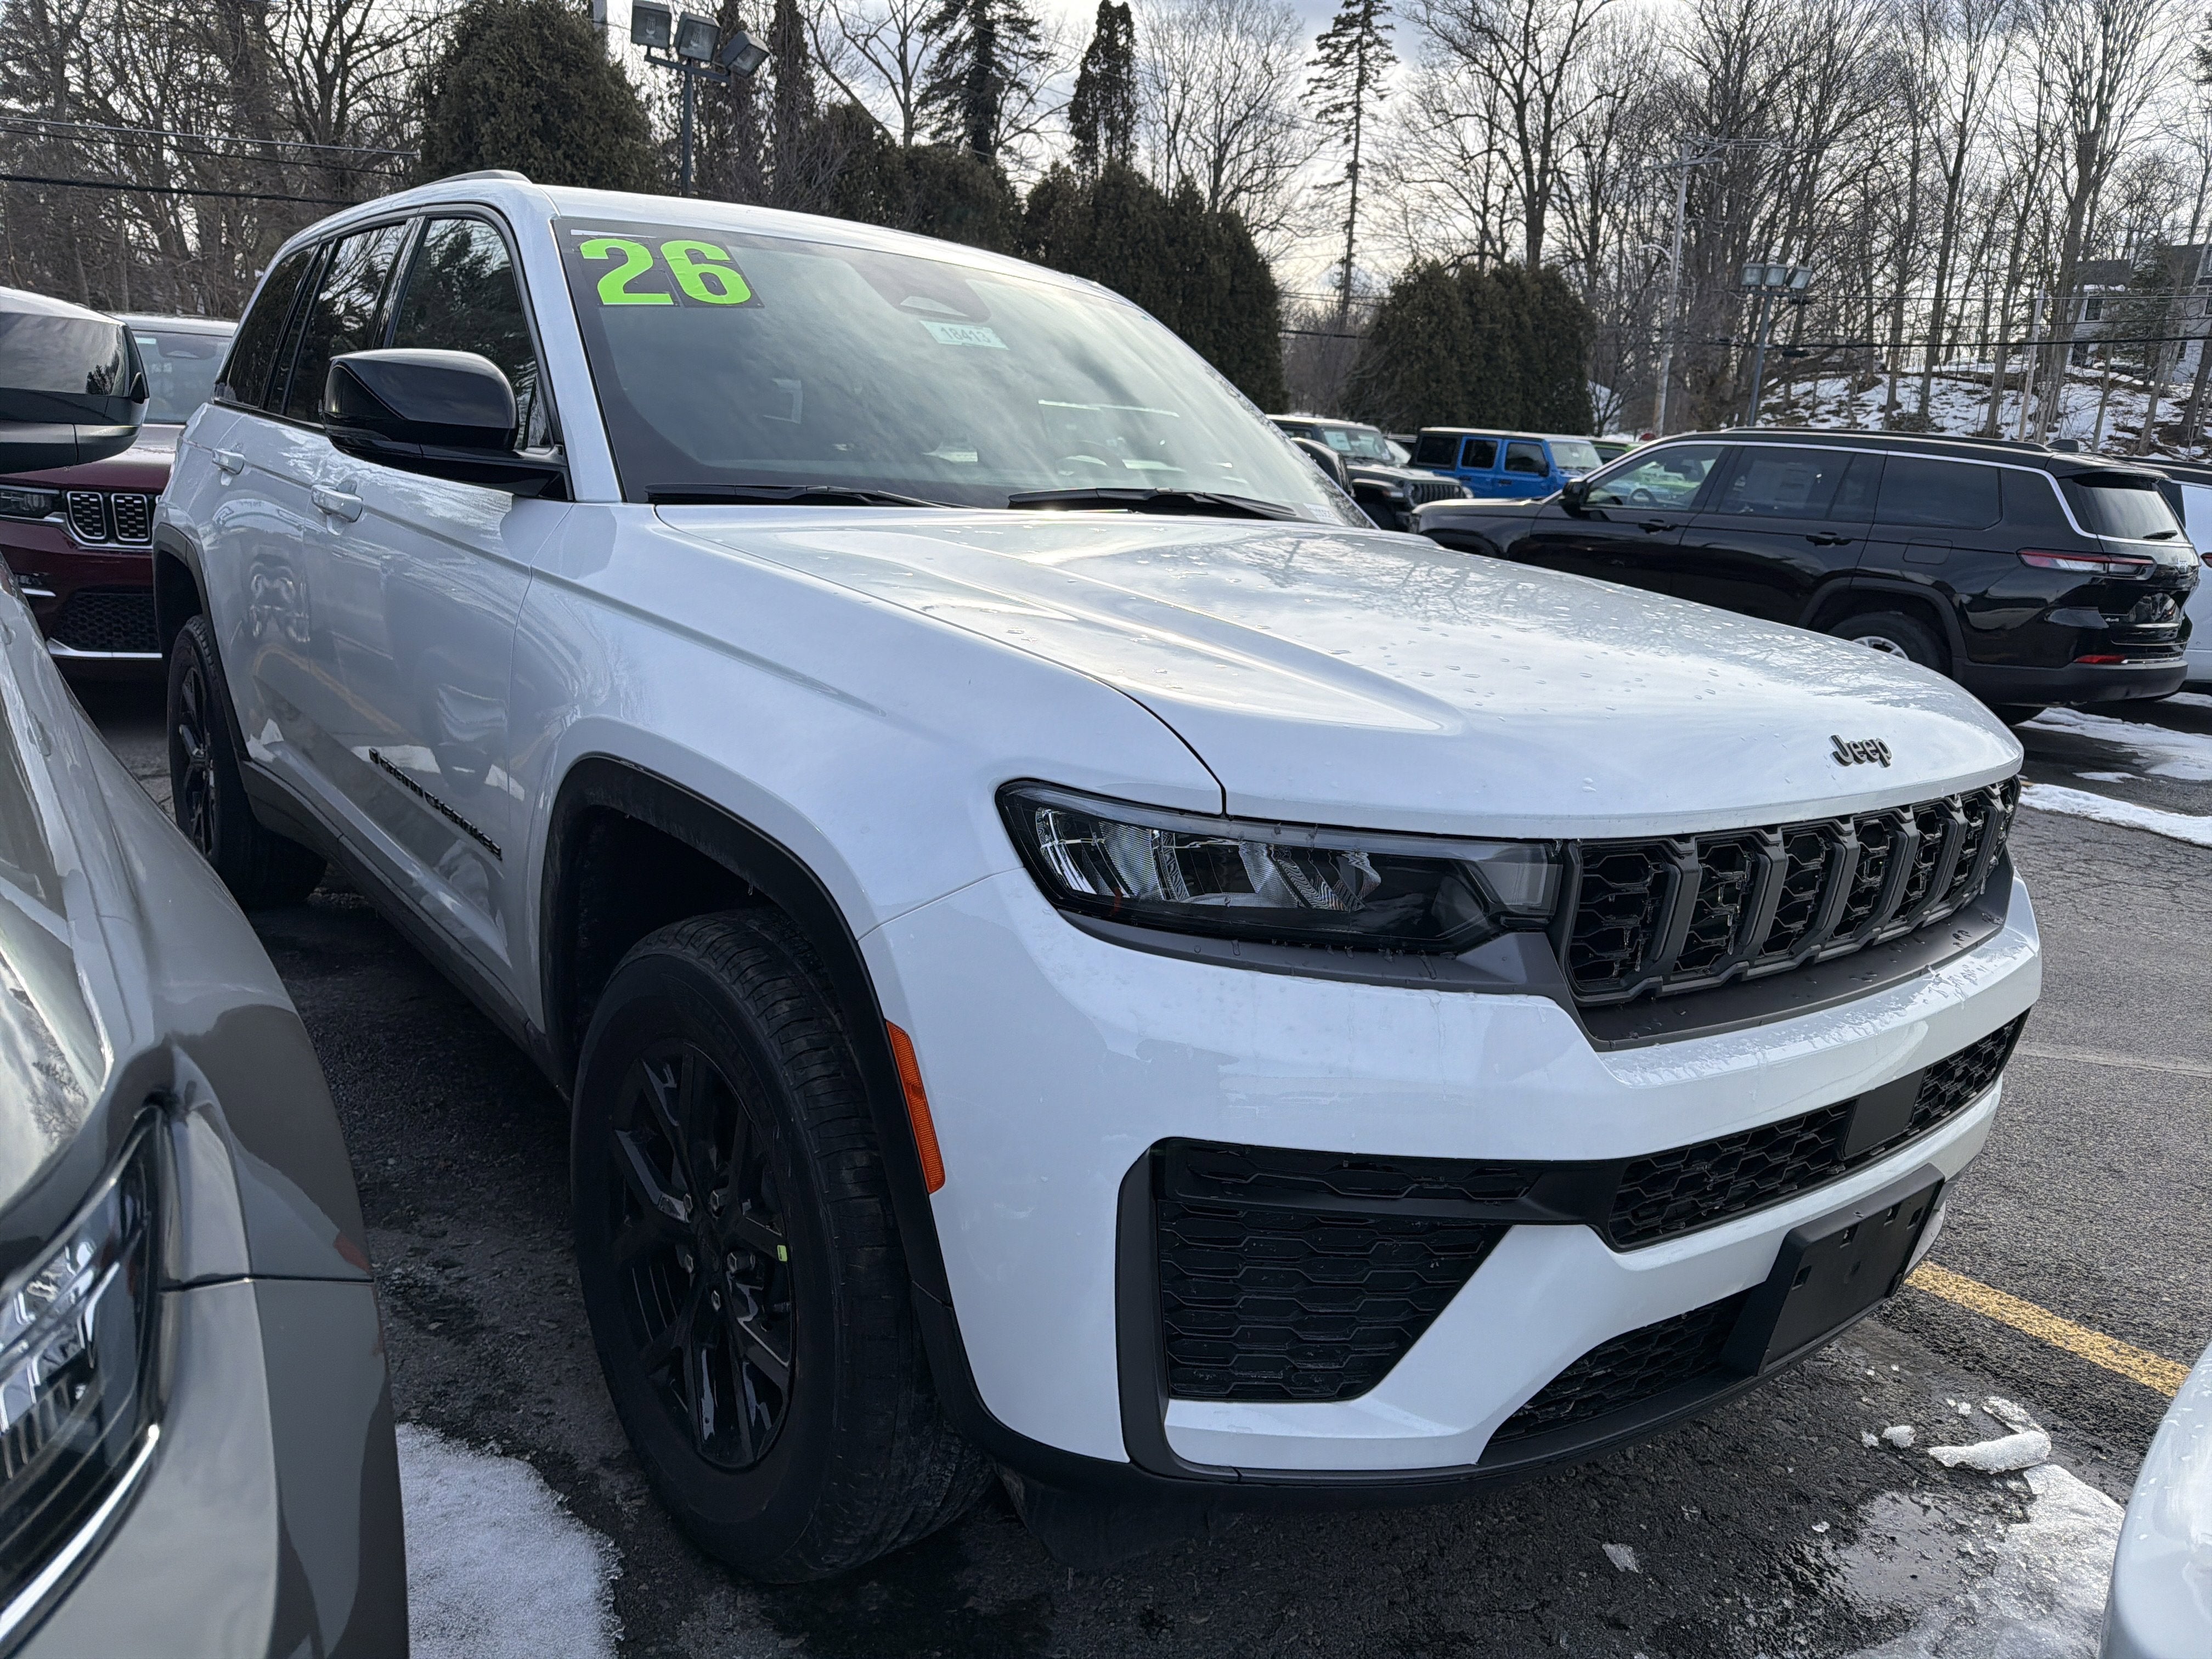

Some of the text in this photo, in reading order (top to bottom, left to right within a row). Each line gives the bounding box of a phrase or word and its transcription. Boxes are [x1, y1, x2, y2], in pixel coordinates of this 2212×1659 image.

[580, 238, 752, 305] 26
[941, 327, 991, 343] 18413
[1830, 735, 1892, 768] Jeep
